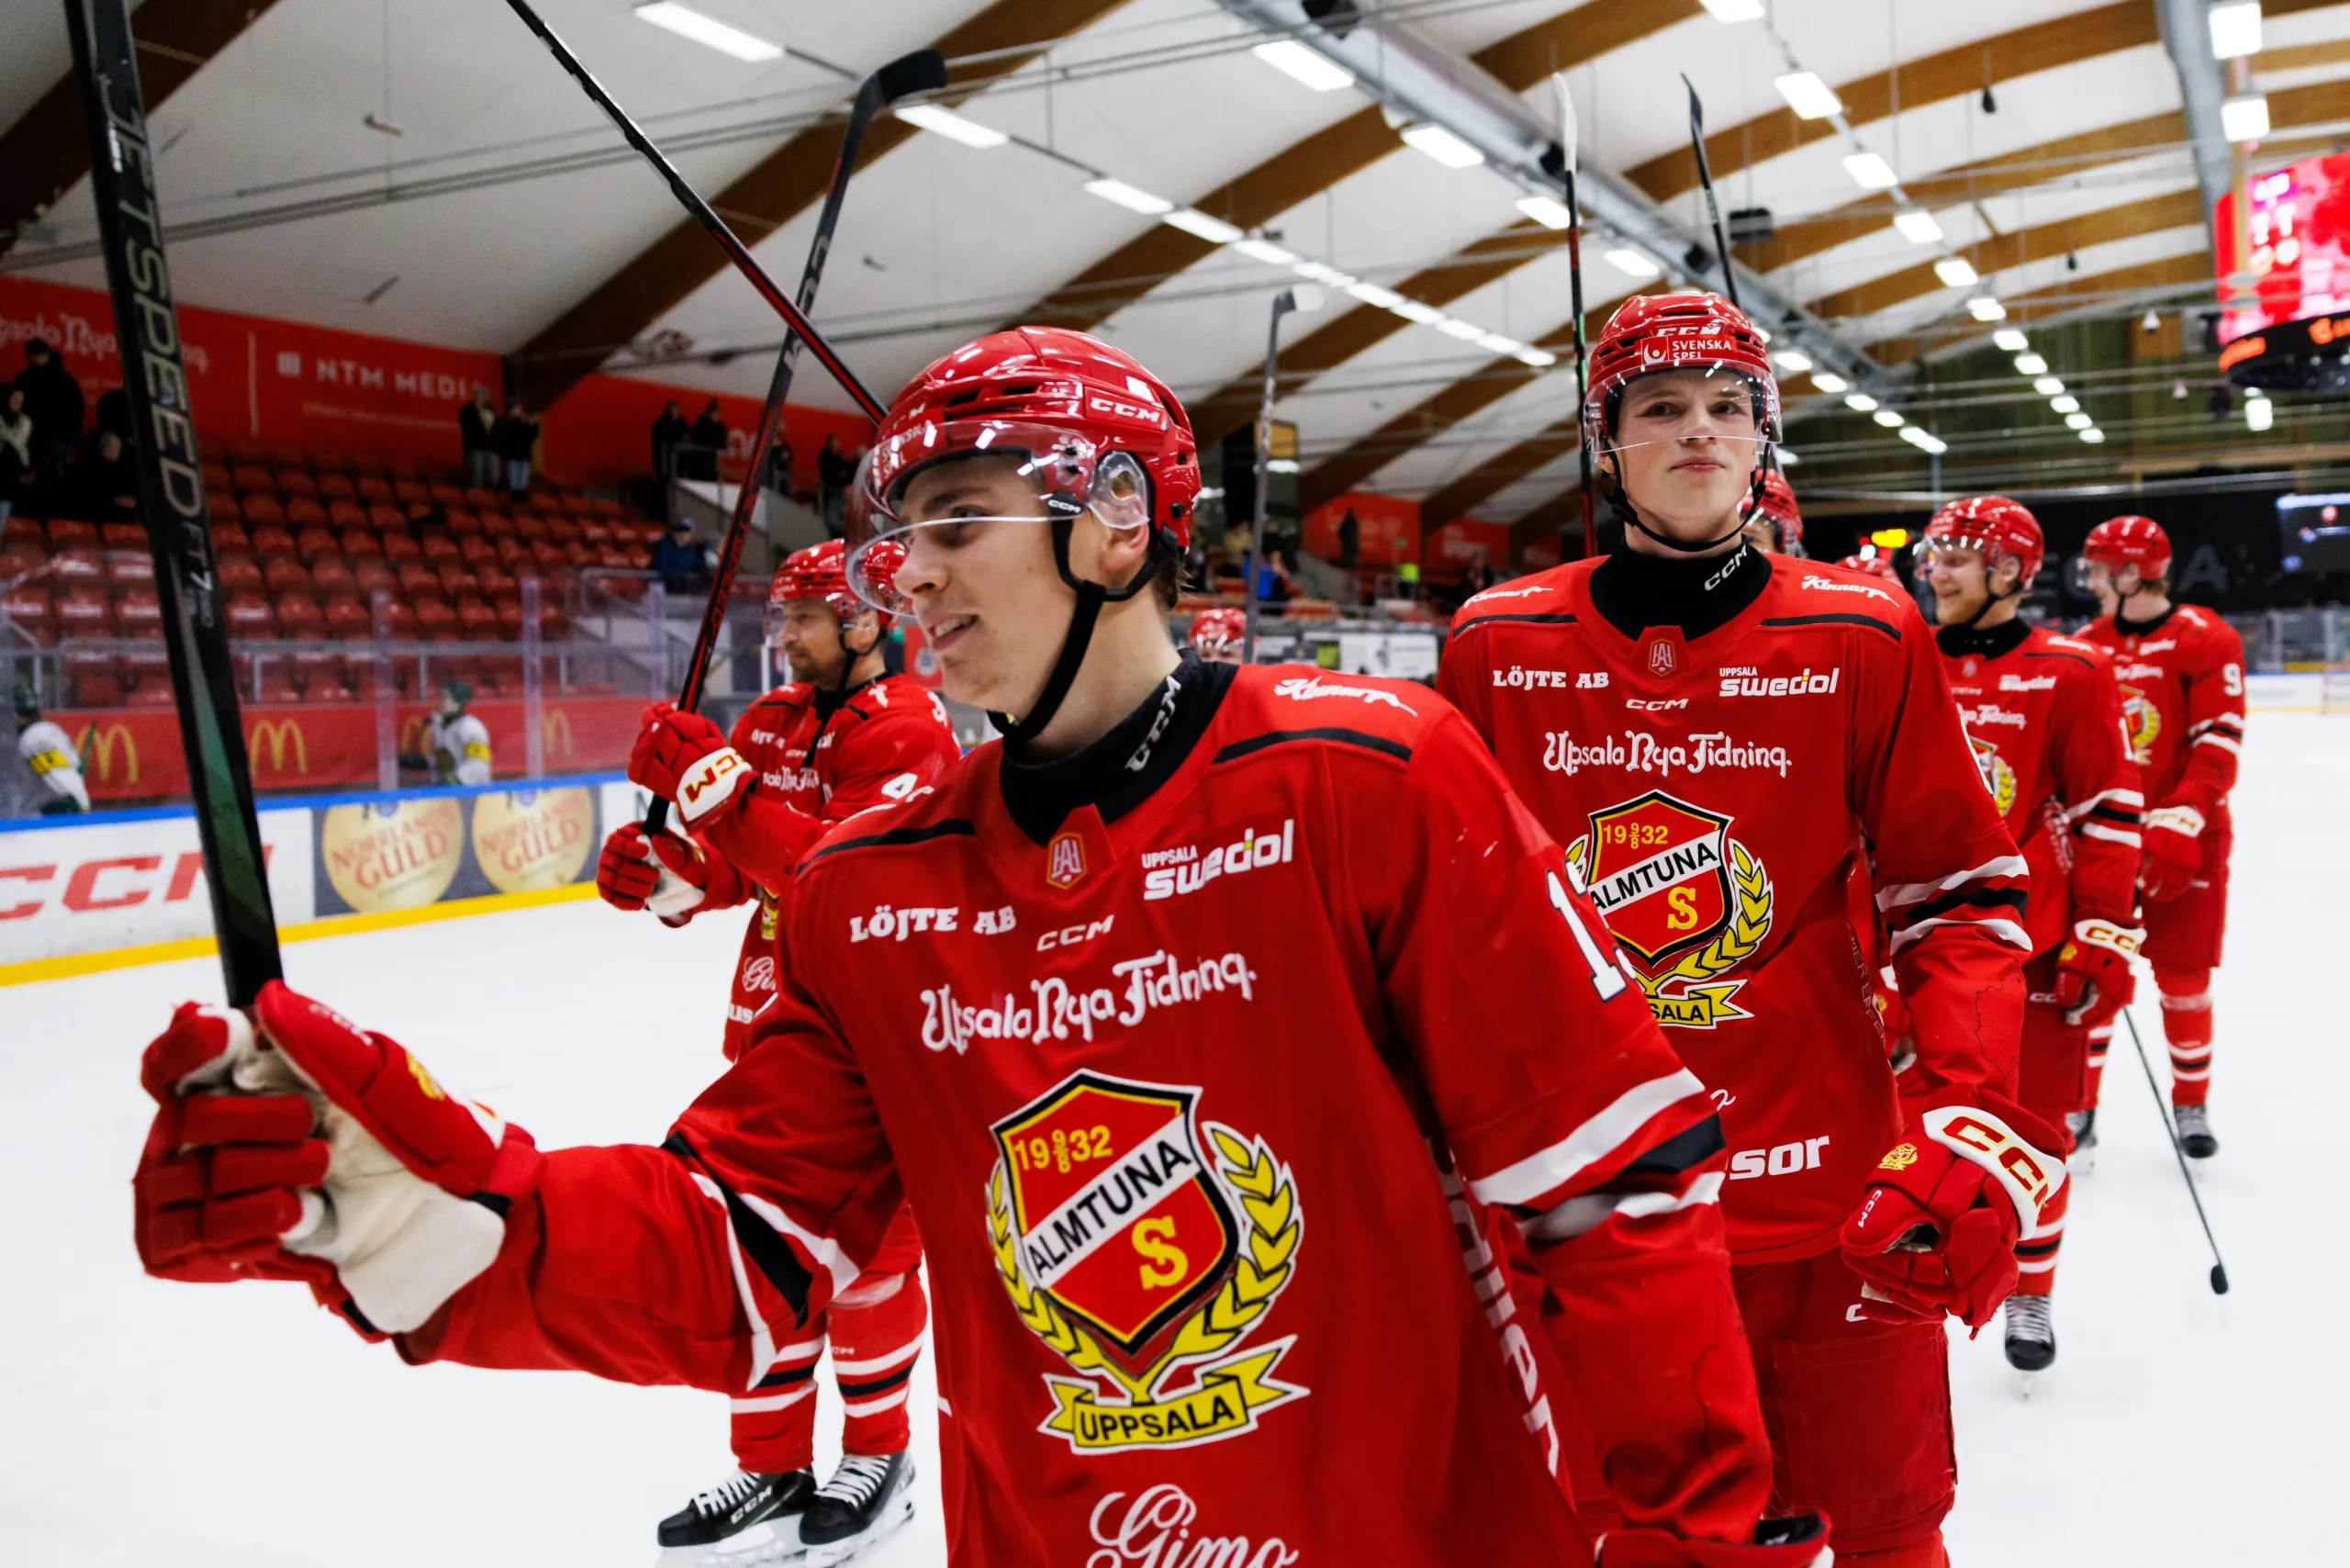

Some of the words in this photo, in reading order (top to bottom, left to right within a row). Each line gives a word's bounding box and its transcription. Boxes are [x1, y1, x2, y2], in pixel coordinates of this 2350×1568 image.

[1672, 340, 1731, 351] SVENSKA
[1673, 351, 1702, 360] SPEL
[395, 370, 467, 400] MEDI
[1090, 396, 1160, 424] CCM
[1047, 498, 1081, 513] CCM
[1704, 544, 1748, 592] CCM
[1493, 666, 1566, 690] LÖJTE
[1575, 671, 1610, 689] AB
[1719, 666, 1758, 677] UPPSALA
[1626, 698, 1689, 711] CCM
[1543, 730, 1625, 777] Upsala
[1625, 730, 1686, 778] Nya
[354, 829, 449, 890] GULD
[498, 817, 581, 873] GULD
[1141, 845, 1199, 869] UPPSALA
[1589, 842, 1718, 911] ALMTUNA
[851, 906, 958, 944] LÖJTE
[973, 905, 1017, 935] AB
[1667, 886, 1698, 930] S
[1036, 914, 1115, 952] CCM
[1546, 857, 1639, 1003] 1
[1031, 977, 1116, 1045] Nya
[1649, 1002, 1706, 1022] SALA
[1729, 1135, 1830, 1181] sor
[1027, 1139, 1192, 1279] ALMTUNA
[1857, 1189, 1883, 1228] CCM
[1131, 1215, 1190, 1291] S
[1080, 1395, 1236, 1441] UPPSALA
[731, 1486, 773, 1524] CCM
[1086, 1483, 1300, 1568] Gimo
